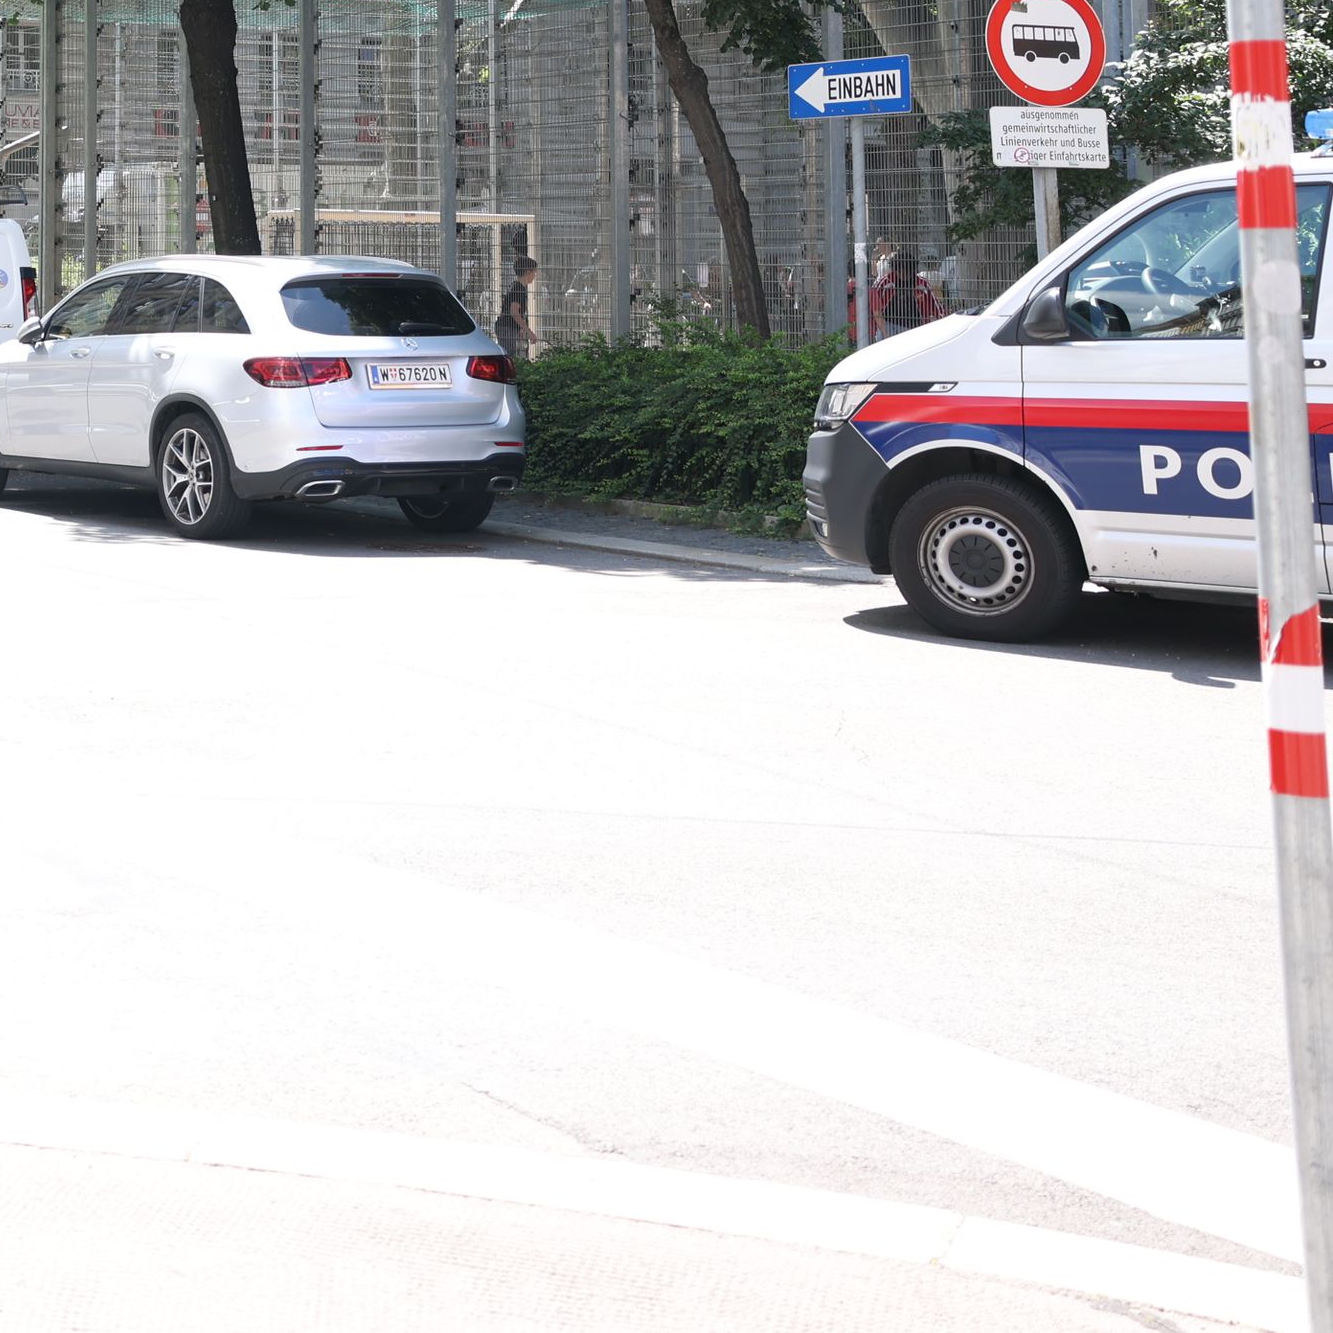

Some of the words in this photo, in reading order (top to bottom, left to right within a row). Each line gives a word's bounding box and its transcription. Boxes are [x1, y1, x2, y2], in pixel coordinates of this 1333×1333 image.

[827, 73, 896, 100] EINBAHN
[1020, 110, 1079, 121] ausgenommen
[1002, 123, 1097, 134] gemeinwirtschaftlicher
[1000, 136, 1059, 147] Linienverkehr
[1060, 138, 1076, 147] und
[1077, 138, 1101, 148] Busse
[1049, 151, 1107, 162] Einfahrtskarte
[380, 368, 390, 381] W
[398, 367, 436, 381] 67620
[438, 367, 447, 381] N
